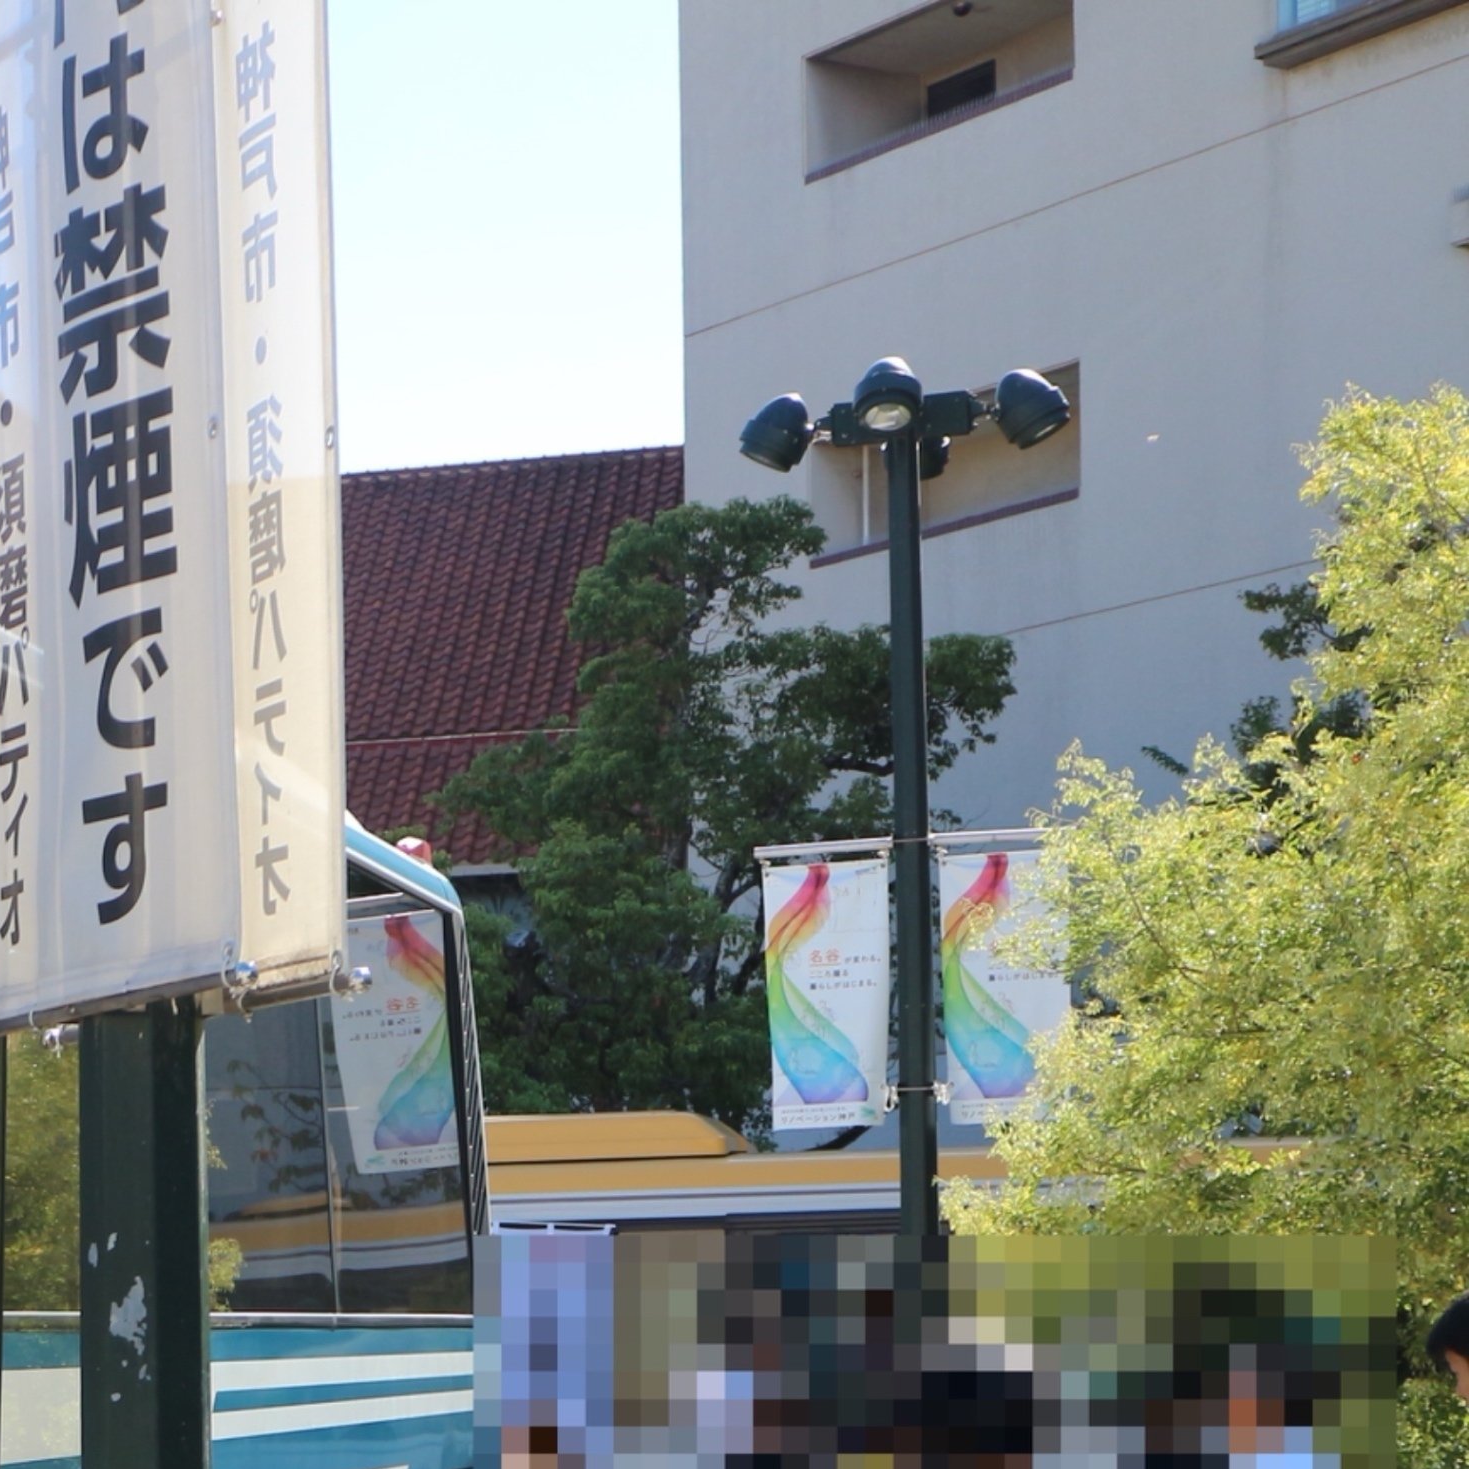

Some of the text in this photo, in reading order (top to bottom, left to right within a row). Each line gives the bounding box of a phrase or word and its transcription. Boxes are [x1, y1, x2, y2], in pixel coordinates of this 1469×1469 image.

[54, 0, 179, 925] は禁煙です
